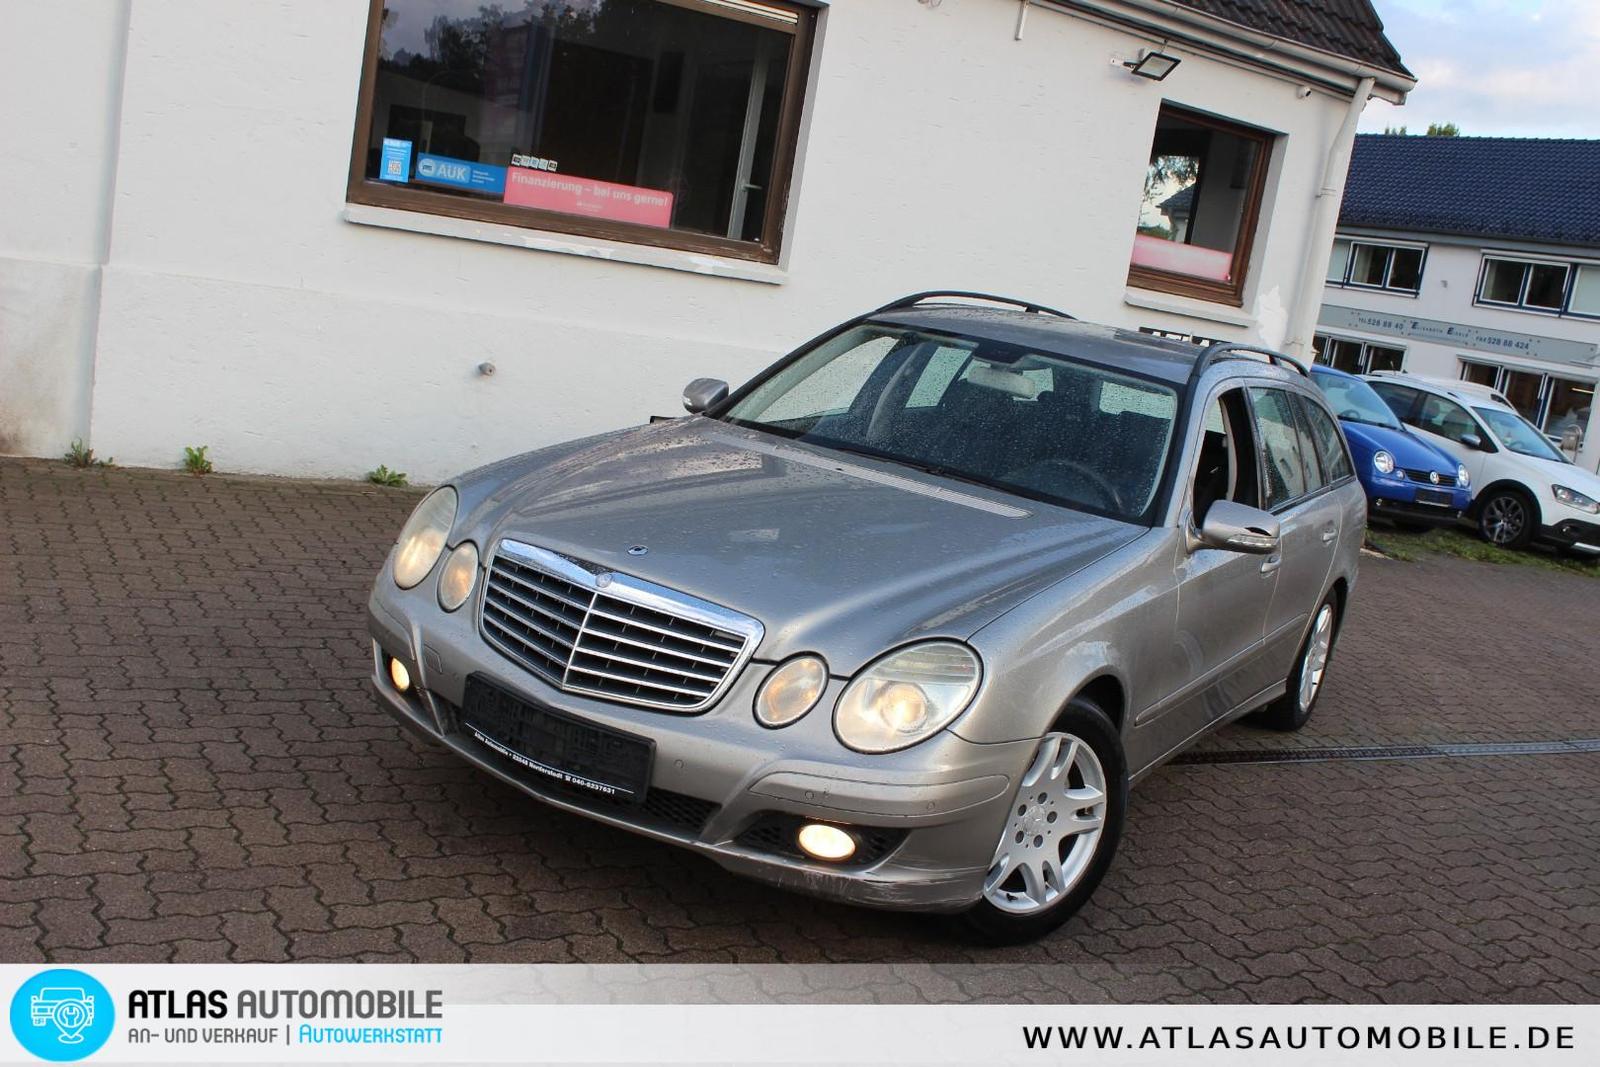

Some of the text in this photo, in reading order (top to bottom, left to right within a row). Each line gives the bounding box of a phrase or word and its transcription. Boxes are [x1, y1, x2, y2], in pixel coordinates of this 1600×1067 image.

[436, 163, 466, 181] AUK
[511, 172, 583, 196] Finanzierung
[593, 185, 610, 197] bei
[613, 189, 632, 201] uns
[633, 193, 668, 206] gerne!
[1514, 340, 1529, 350] 424
